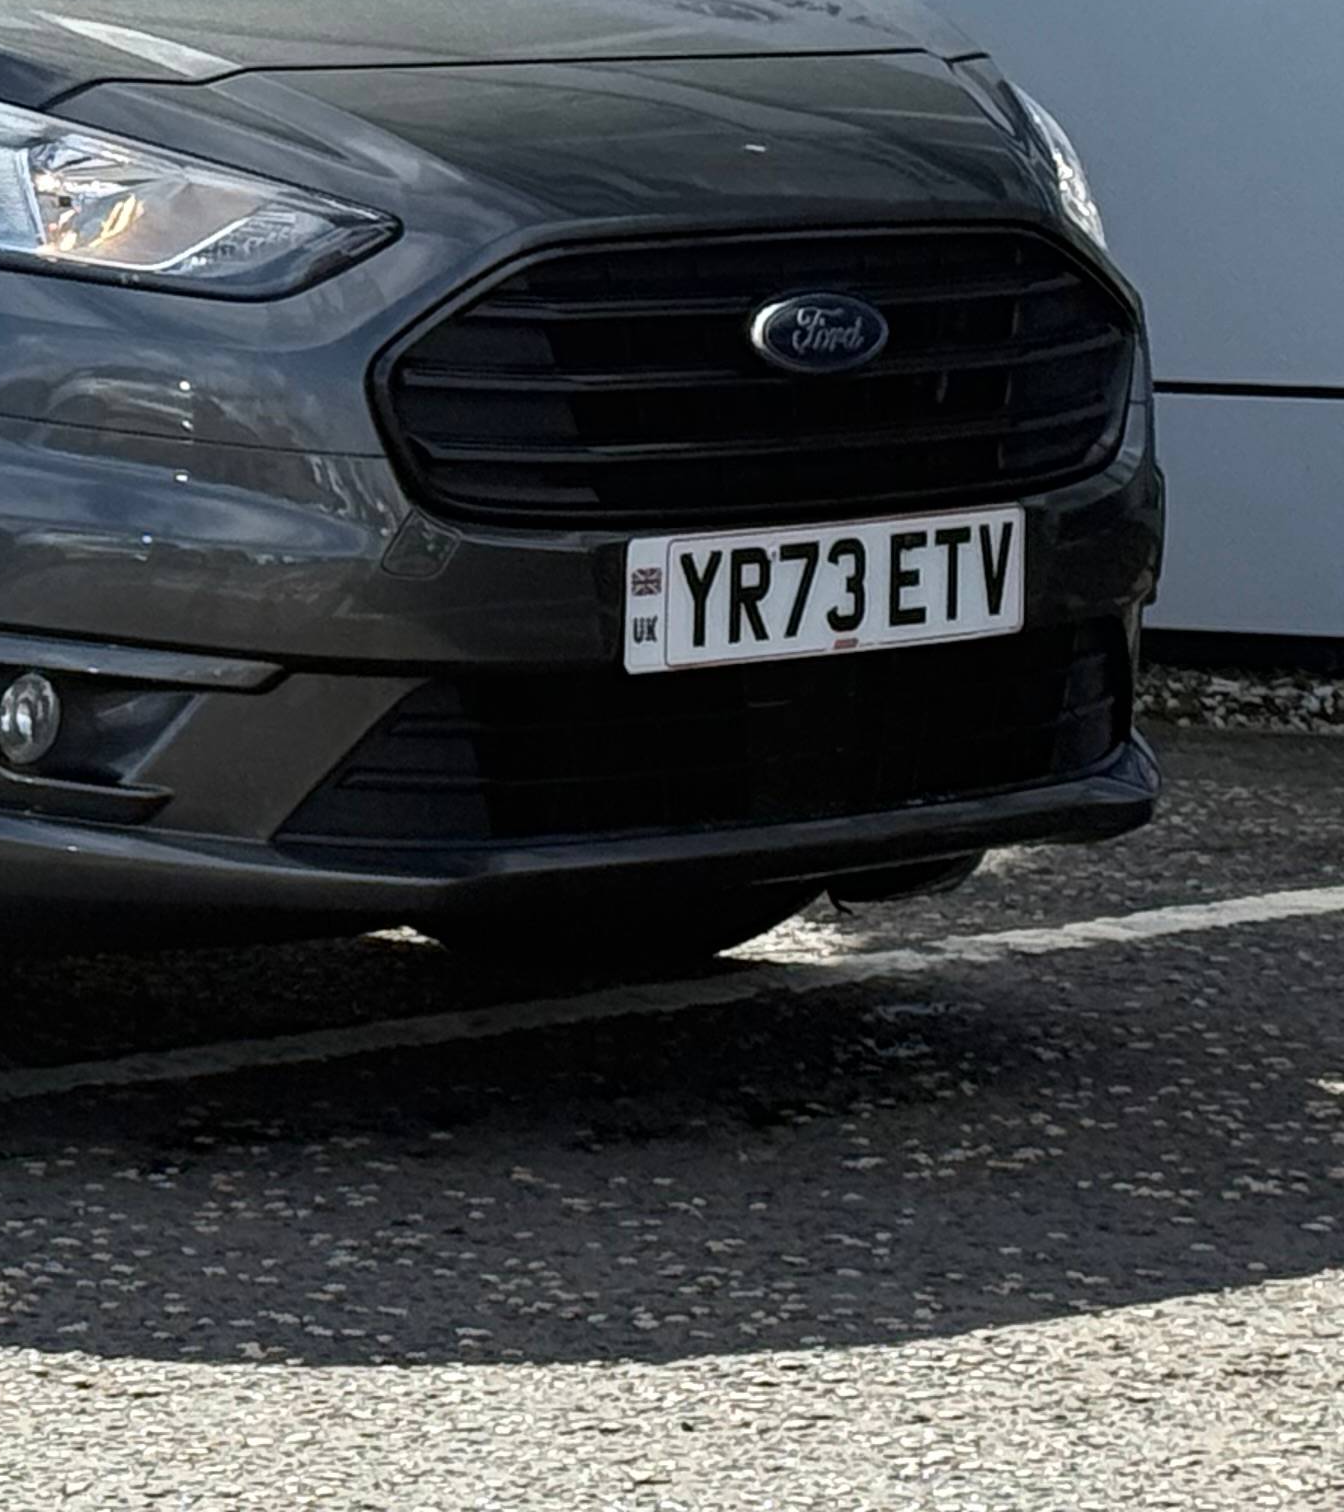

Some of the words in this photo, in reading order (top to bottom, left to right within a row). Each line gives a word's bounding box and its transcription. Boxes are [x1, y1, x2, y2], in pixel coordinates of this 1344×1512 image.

[792, 306, 864, 355] Ford
[679, 536, 867, 648] YR73
[888, 521, 1014, 627] ETV
[633, 614, 659, 645] UK
